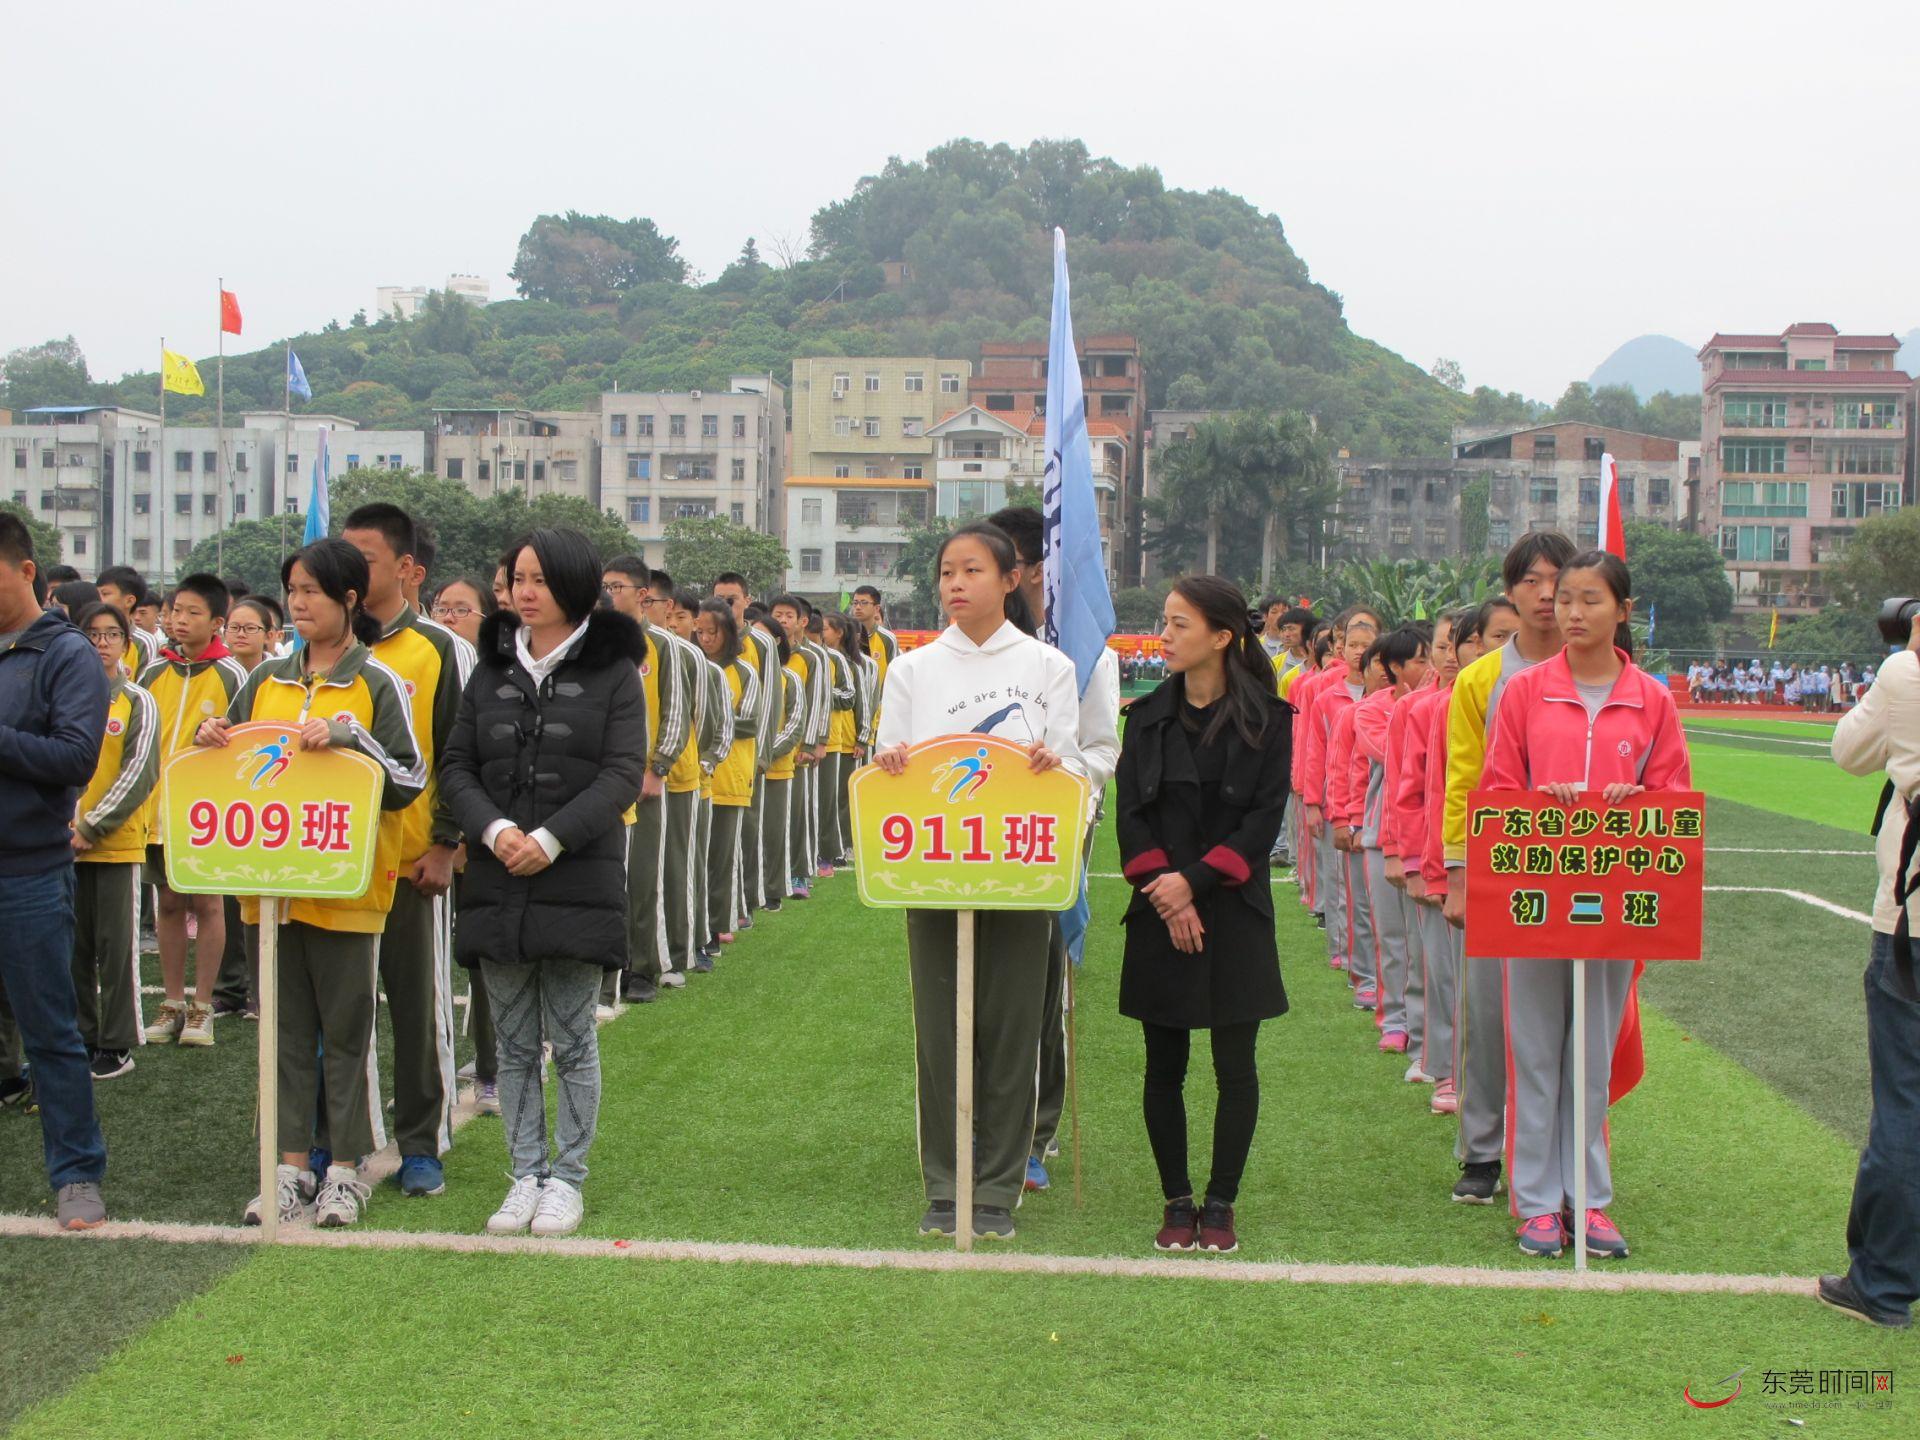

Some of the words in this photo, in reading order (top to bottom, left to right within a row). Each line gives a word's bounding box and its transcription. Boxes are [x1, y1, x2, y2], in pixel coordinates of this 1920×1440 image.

[947, 700, 967, 715] we
[974, 690, 998, 704] are
[1006, 685, 1029, 700] the
[188, 800, 351, 852] 909班
[1472, 807, 1702, 838] 广东省少年儿童
[881, 813, 1057, 865] 911班
[1490, 844, 1685, 875] 救助保护中心
